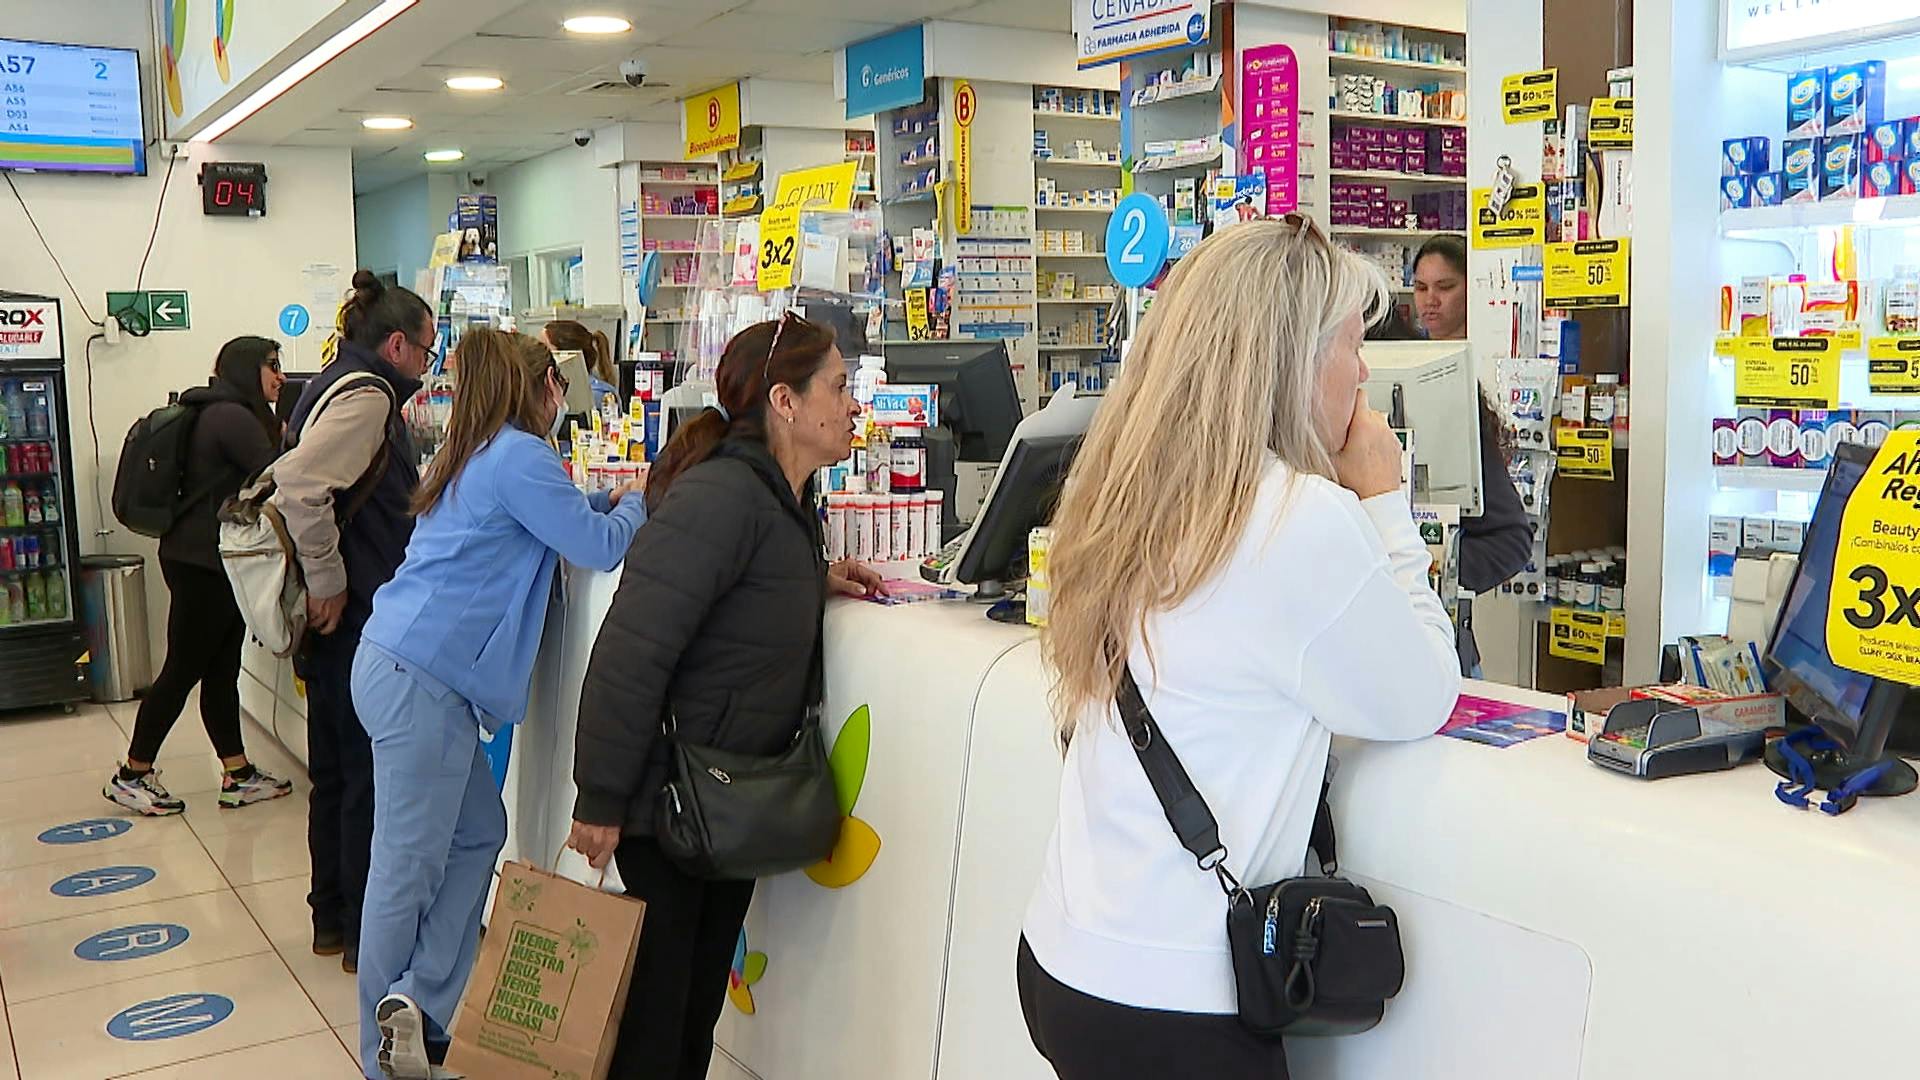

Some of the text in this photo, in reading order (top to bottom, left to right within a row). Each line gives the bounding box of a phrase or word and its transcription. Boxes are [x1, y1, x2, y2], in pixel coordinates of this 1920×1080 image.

[1097, 22, 1181, 48] FARMACIA ADHERIDA
[94, 61, 108, 80] 2
[873, 67, 910, 86] Genéricos
[708, 102, 718, 128] B
[960, 92, 970, 121] B
[215, 181, 254, 206] 04
[1121, 207, 1146, 264] 2
[761, 236, 795, 269] 3x2
[1588, 265, 1604, 285] 50
[287, 310, 299, 330] 7
[911, 325, 930, 340] 3x2
[1790, 364, 1809, 386] 50
[1587, 448, 1599, 463] 50
[1872, 519, 1920, 541] Beauty
[55, 822, 117, 836] F
[71, 872, 138, 895] A
[98, 927, 170, 958] R
[509, 945, 565, 974] NUESTRA
[500, 974, 541, 998] VERDE
[126, 997, 214, 1037] M
[496, 988, 560, 1022] NUESTRAS
